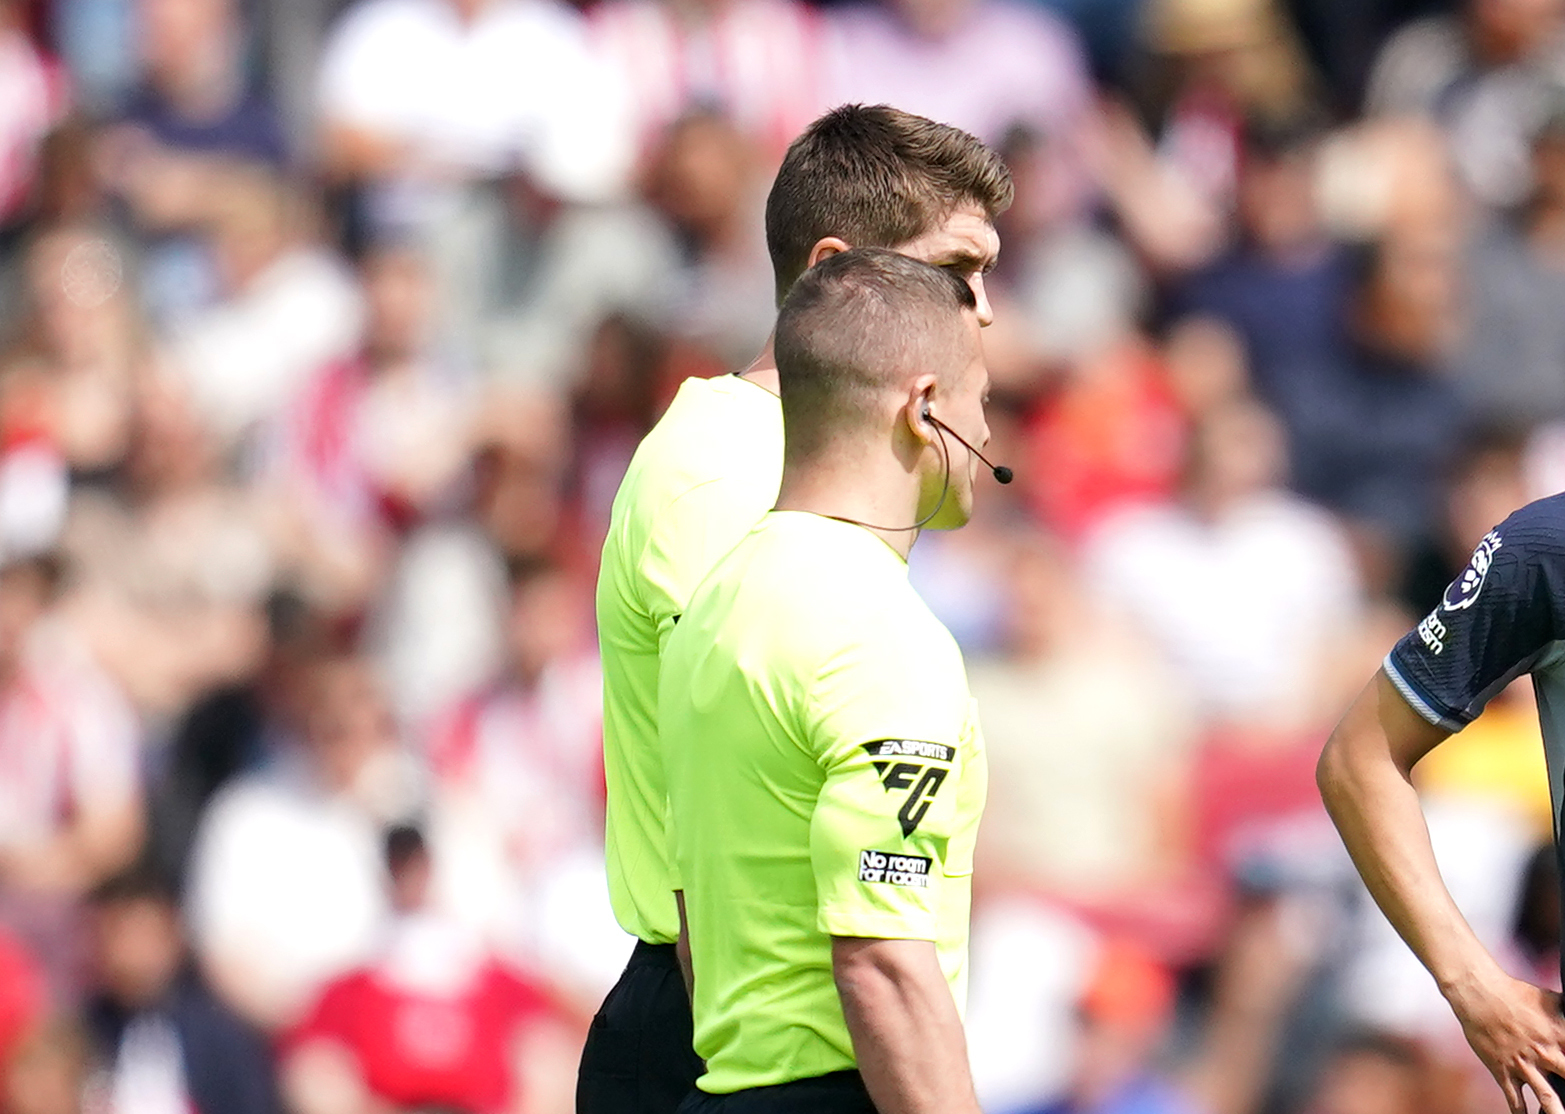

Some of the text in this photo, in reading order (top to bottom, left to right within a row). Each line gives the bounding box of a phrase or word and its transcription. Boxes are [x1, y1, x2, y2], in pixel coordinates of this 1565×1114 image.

[879, 741, 948, 760] EA SPORTS
[882, 762, 949, 839] FC
[860, 851, 927, 874] No room
